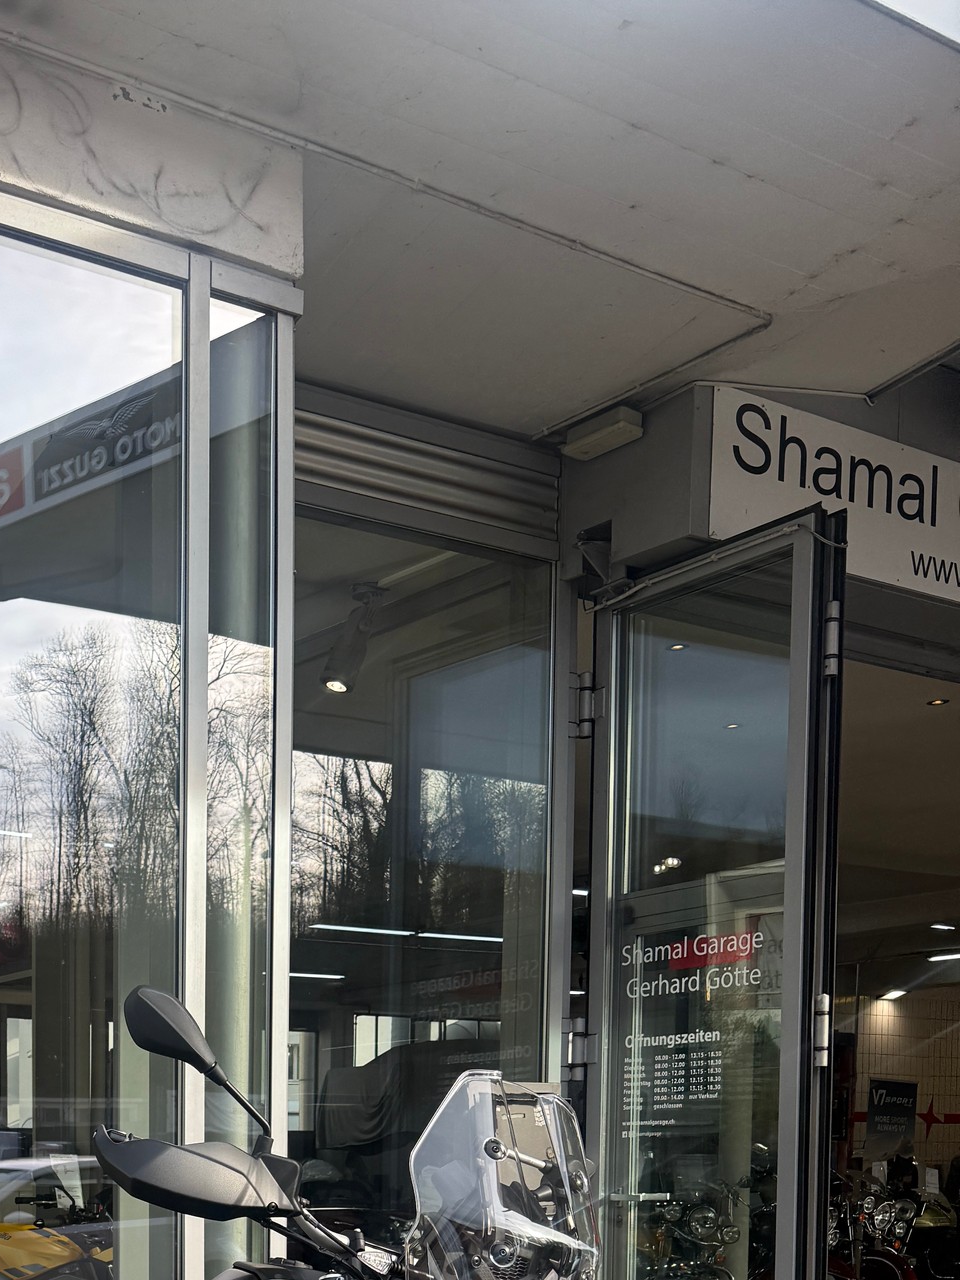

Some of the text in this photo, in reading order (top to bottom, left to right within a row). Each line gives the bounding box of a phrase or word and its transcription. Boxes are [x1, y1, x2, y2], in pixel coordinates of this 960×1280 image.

[732, 403, 938, 527] Shamal
[622, 931, 764, 966] Shamal Garage
[626, 966, 762, 999] Gerhard Götte
[872, 1088, 914, 1106] V7 SPORT
